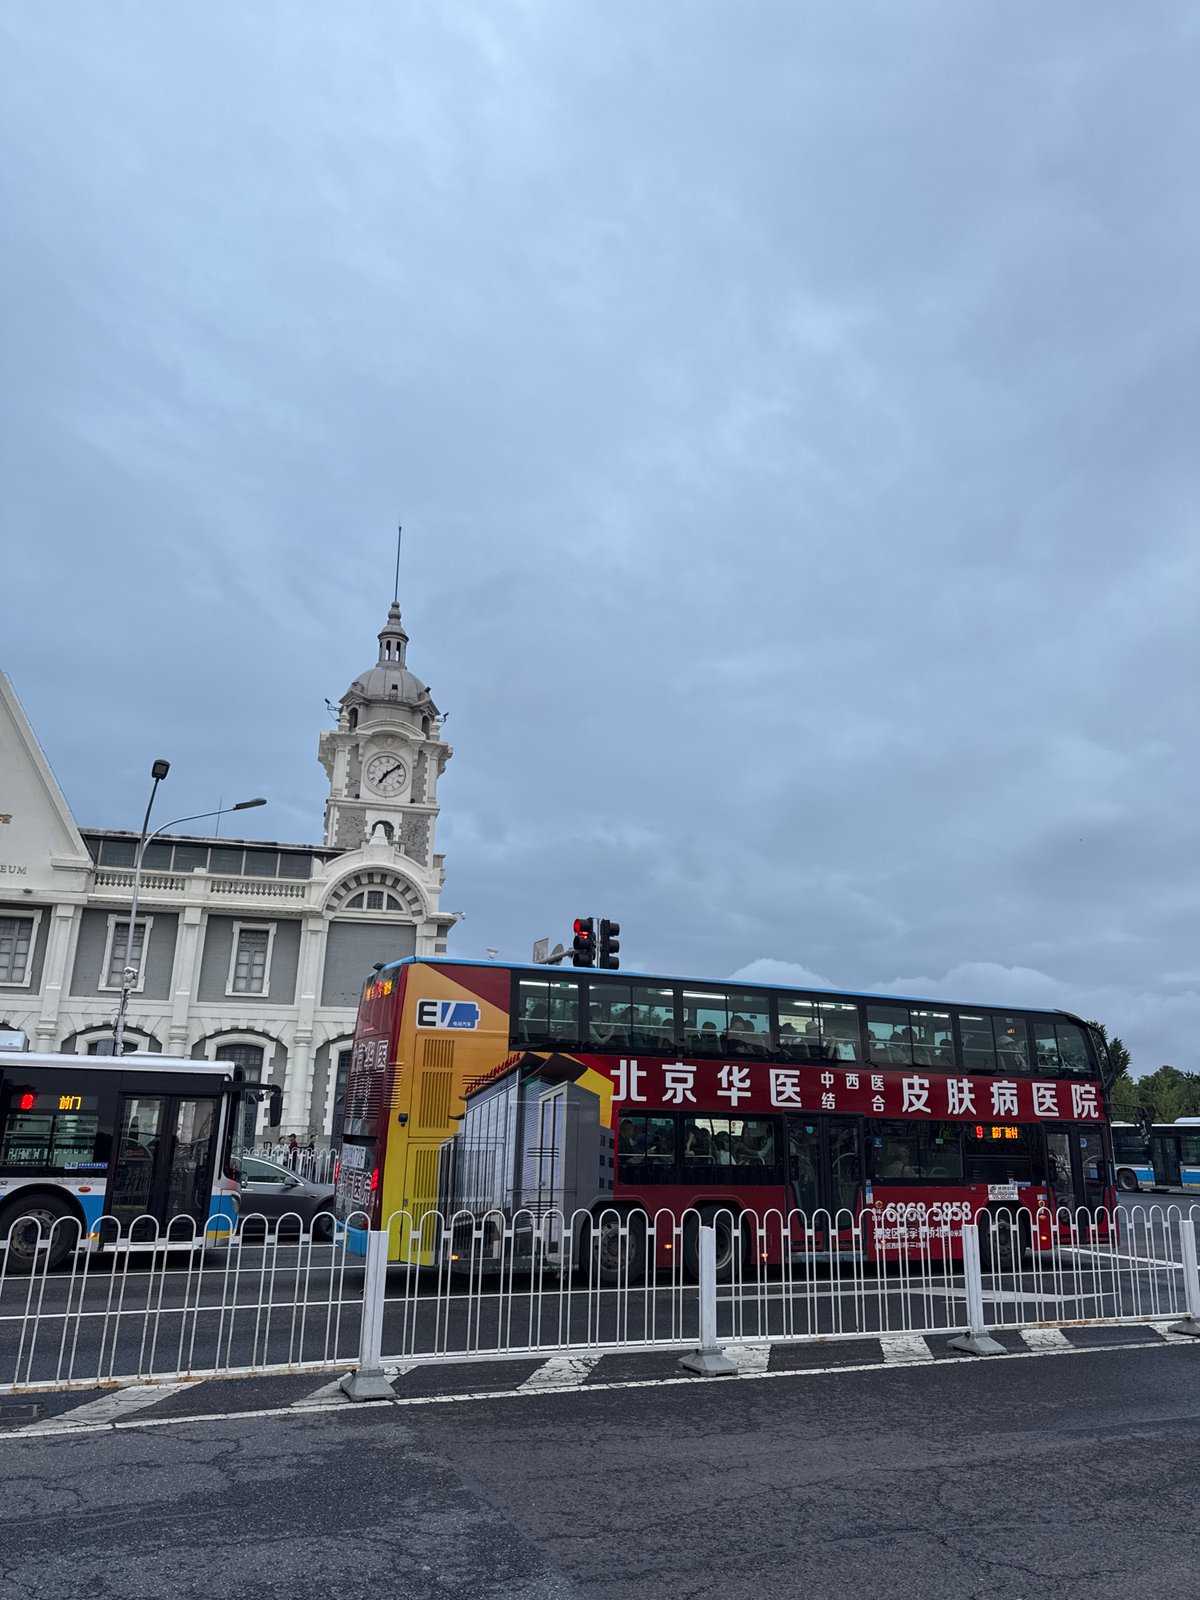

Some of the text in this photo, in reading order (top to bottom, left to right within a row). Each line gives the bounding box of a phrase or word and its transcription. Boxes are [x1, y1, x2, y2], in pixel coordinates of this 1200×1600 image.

[418, 1001, 457, 1028] EV
[610, 1059, 802, 1108] 北京华医
[59, 1095, 82, 1110] 前门
[902, 1075, 1099, 1120] 皮肤病医院
[975, 1125, 984, 1139] 9
